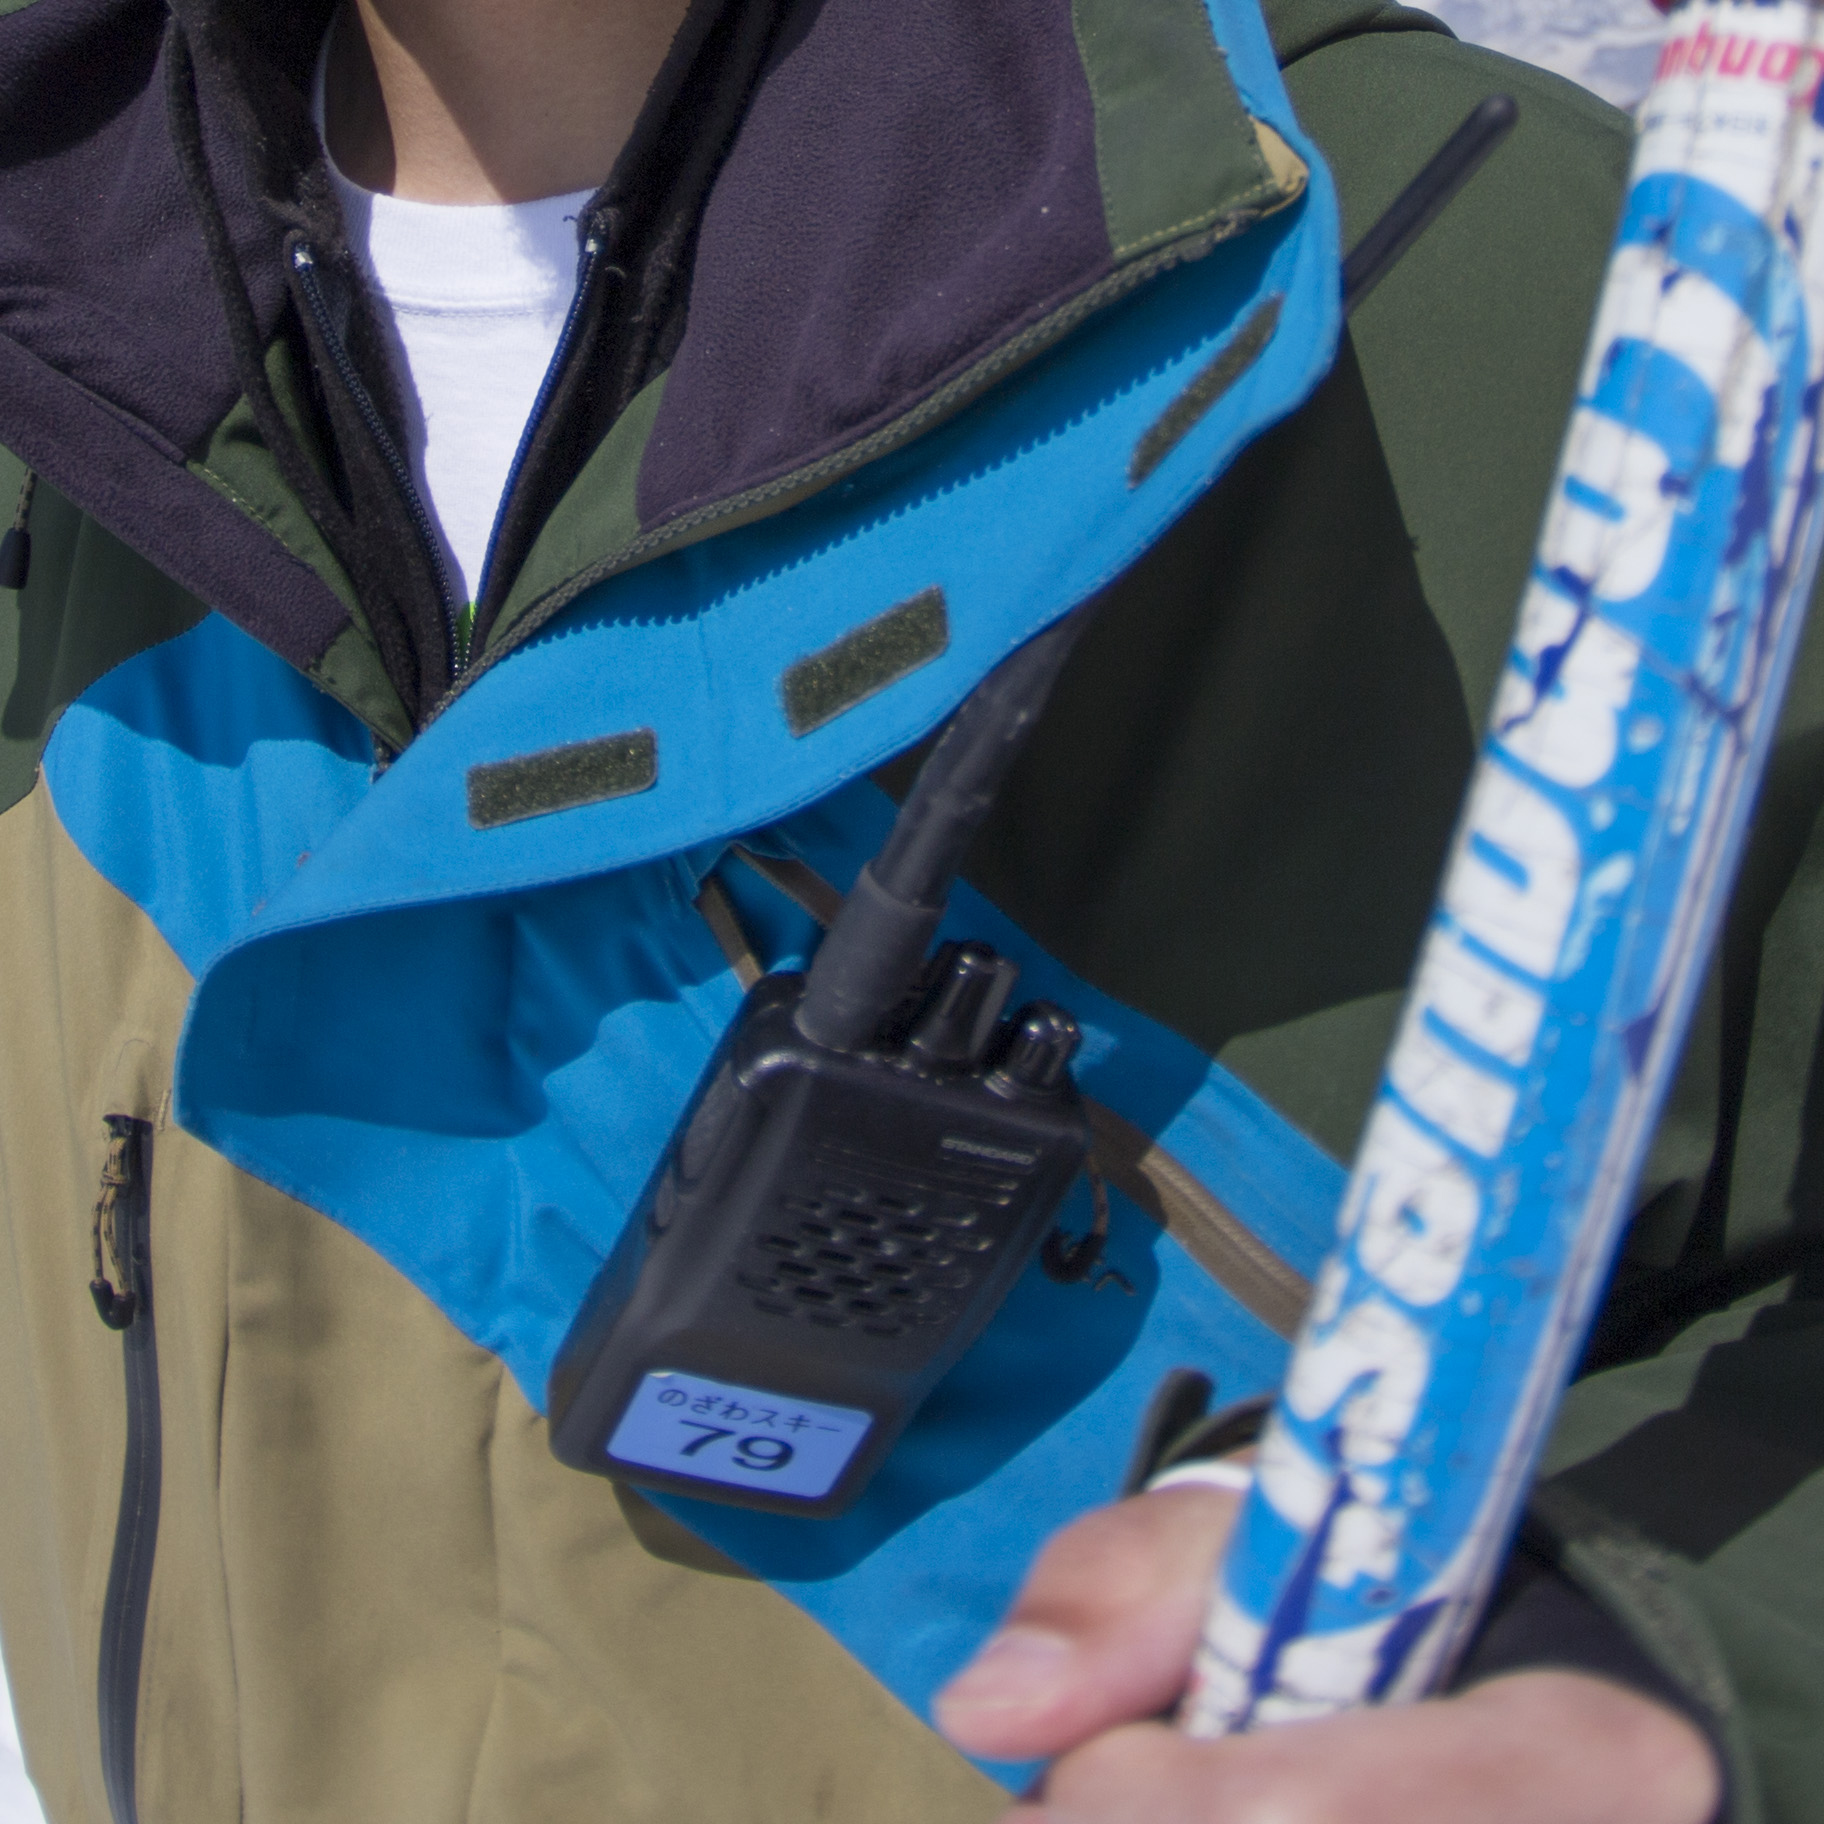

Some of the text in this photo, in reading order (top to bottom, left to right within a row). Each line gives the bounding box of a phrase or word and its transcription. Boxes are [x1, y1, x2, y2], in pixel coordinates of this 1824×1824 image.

[656, 1388, 842, 1433] のざわスキー
[678, 1419, 795, 1471] 79
